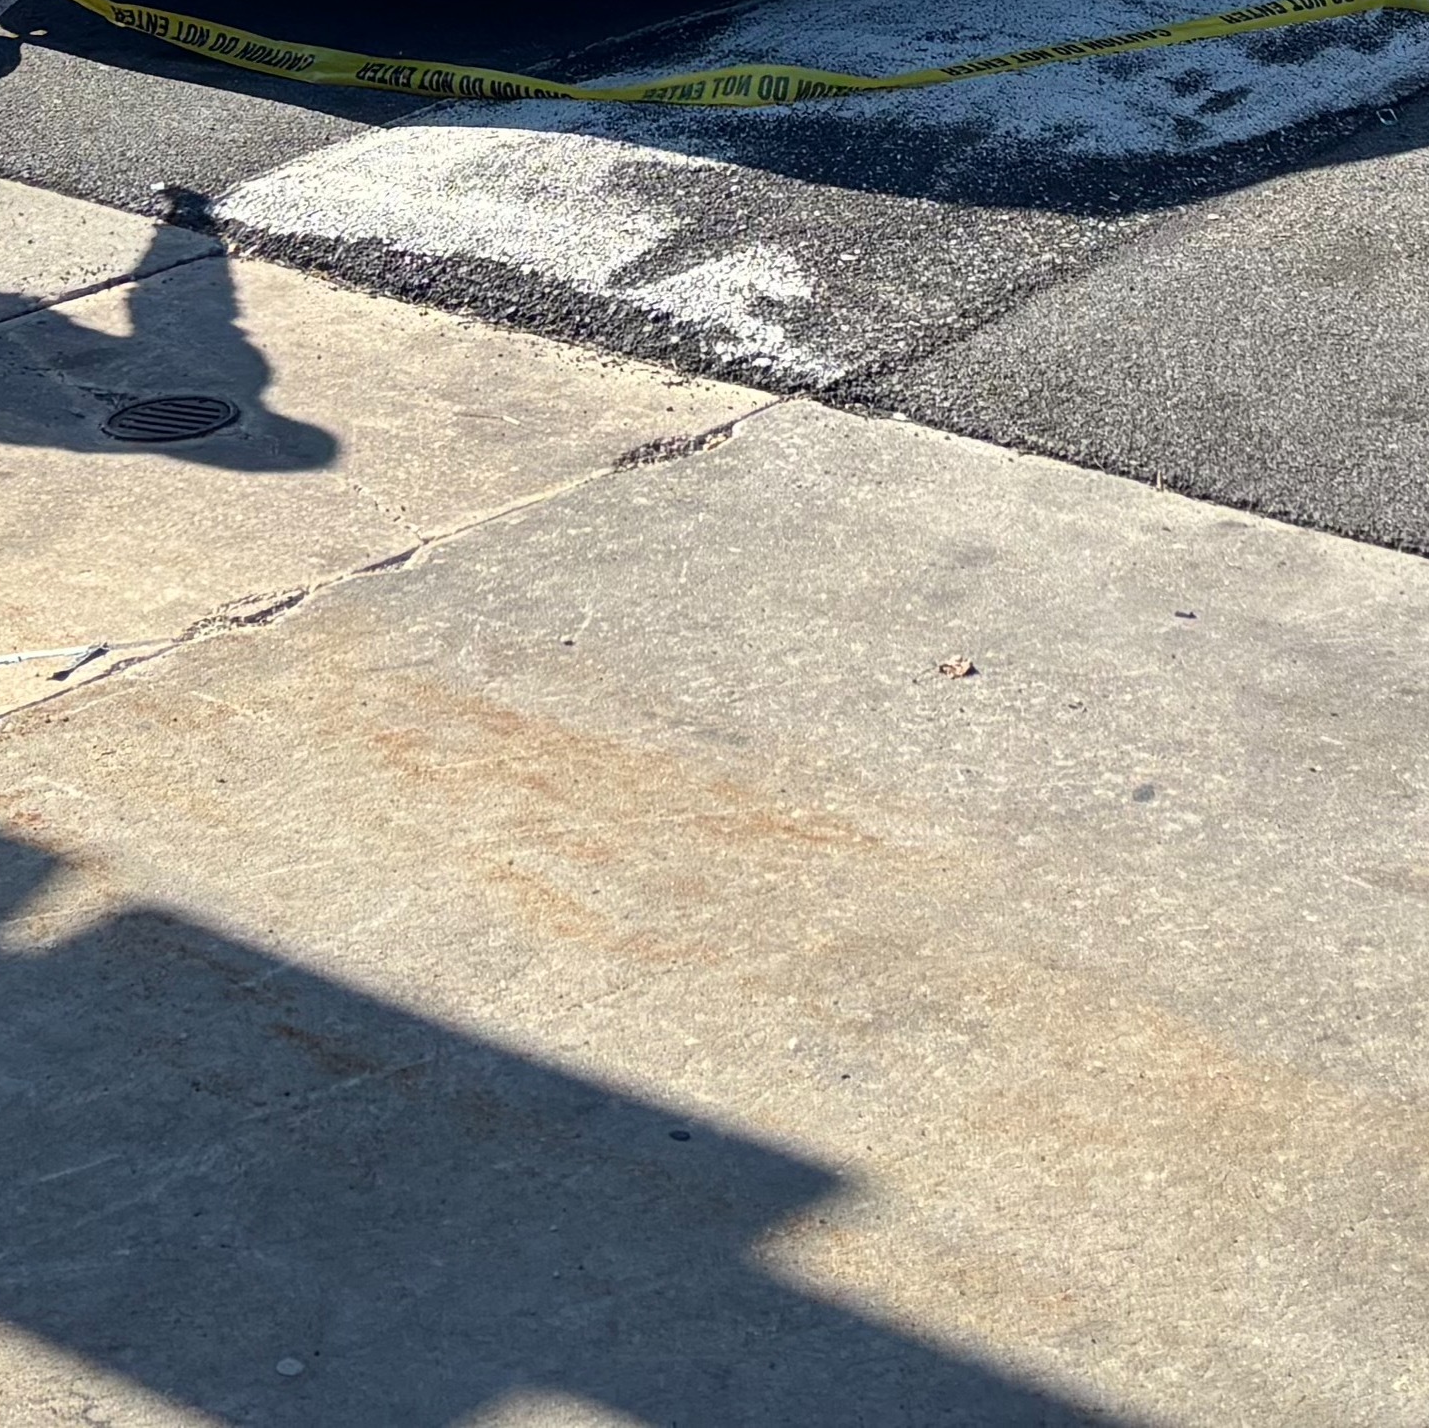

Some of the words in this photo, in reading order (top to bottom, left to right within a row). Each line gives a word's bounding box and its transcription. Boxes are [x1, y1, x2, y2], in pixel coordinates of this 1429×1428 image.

[111, 5, 170, 37] ENTER
[1219, 1, 1288, 24] ENTER
[170, 21, 211, 48] NOT
[208, 32, 240, 55] DO
[234, 40, 316, 72] CAUTION
[1010, 49, 1055, 63] NOT
[1051, 43, 1087, 55] DO
[355, 62, 418, 89] ENTER
[940, 56, 1011, 77] ENTER
[417, 68, 455, 94] NOT
[458, 75, 484, 98] DO
